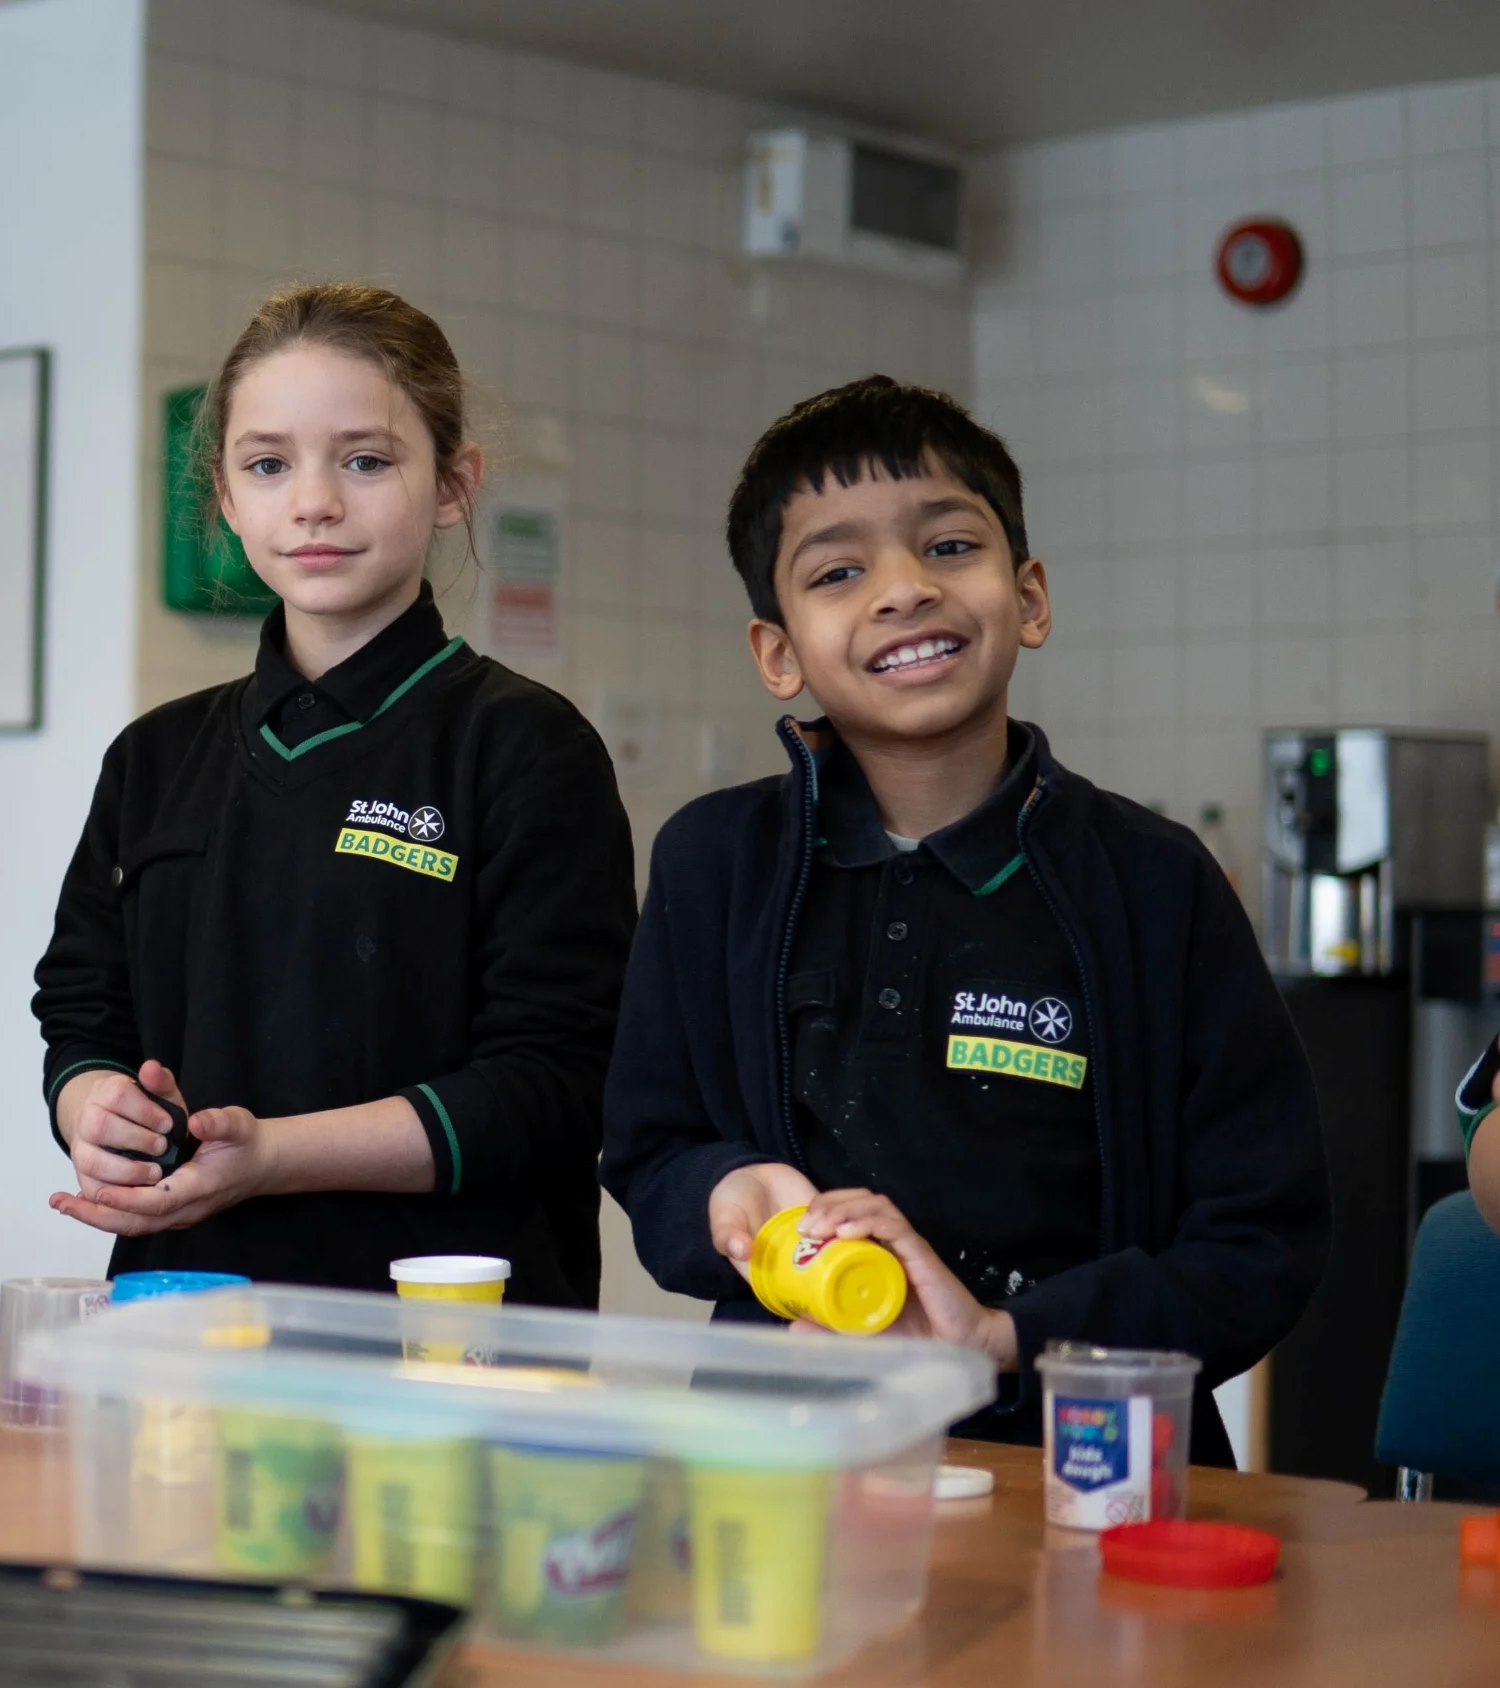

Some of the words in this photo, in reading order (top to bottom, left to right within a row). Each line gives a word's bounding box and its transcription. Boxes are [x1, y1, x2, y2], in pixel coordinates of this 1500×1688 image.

[346, 813, 406, 833] Ambulance
[350, 800, 368, 814] St
[368, 800, 409, 824] John
[340, 832, 453, 877] BADGERS
[953, 991, 976, 1012] St
[976, 993, 1027, 1018] John
[951, 1011, 1025, 1031] Ambulance
[951, 1040, 1083, 1084] BADGERS
